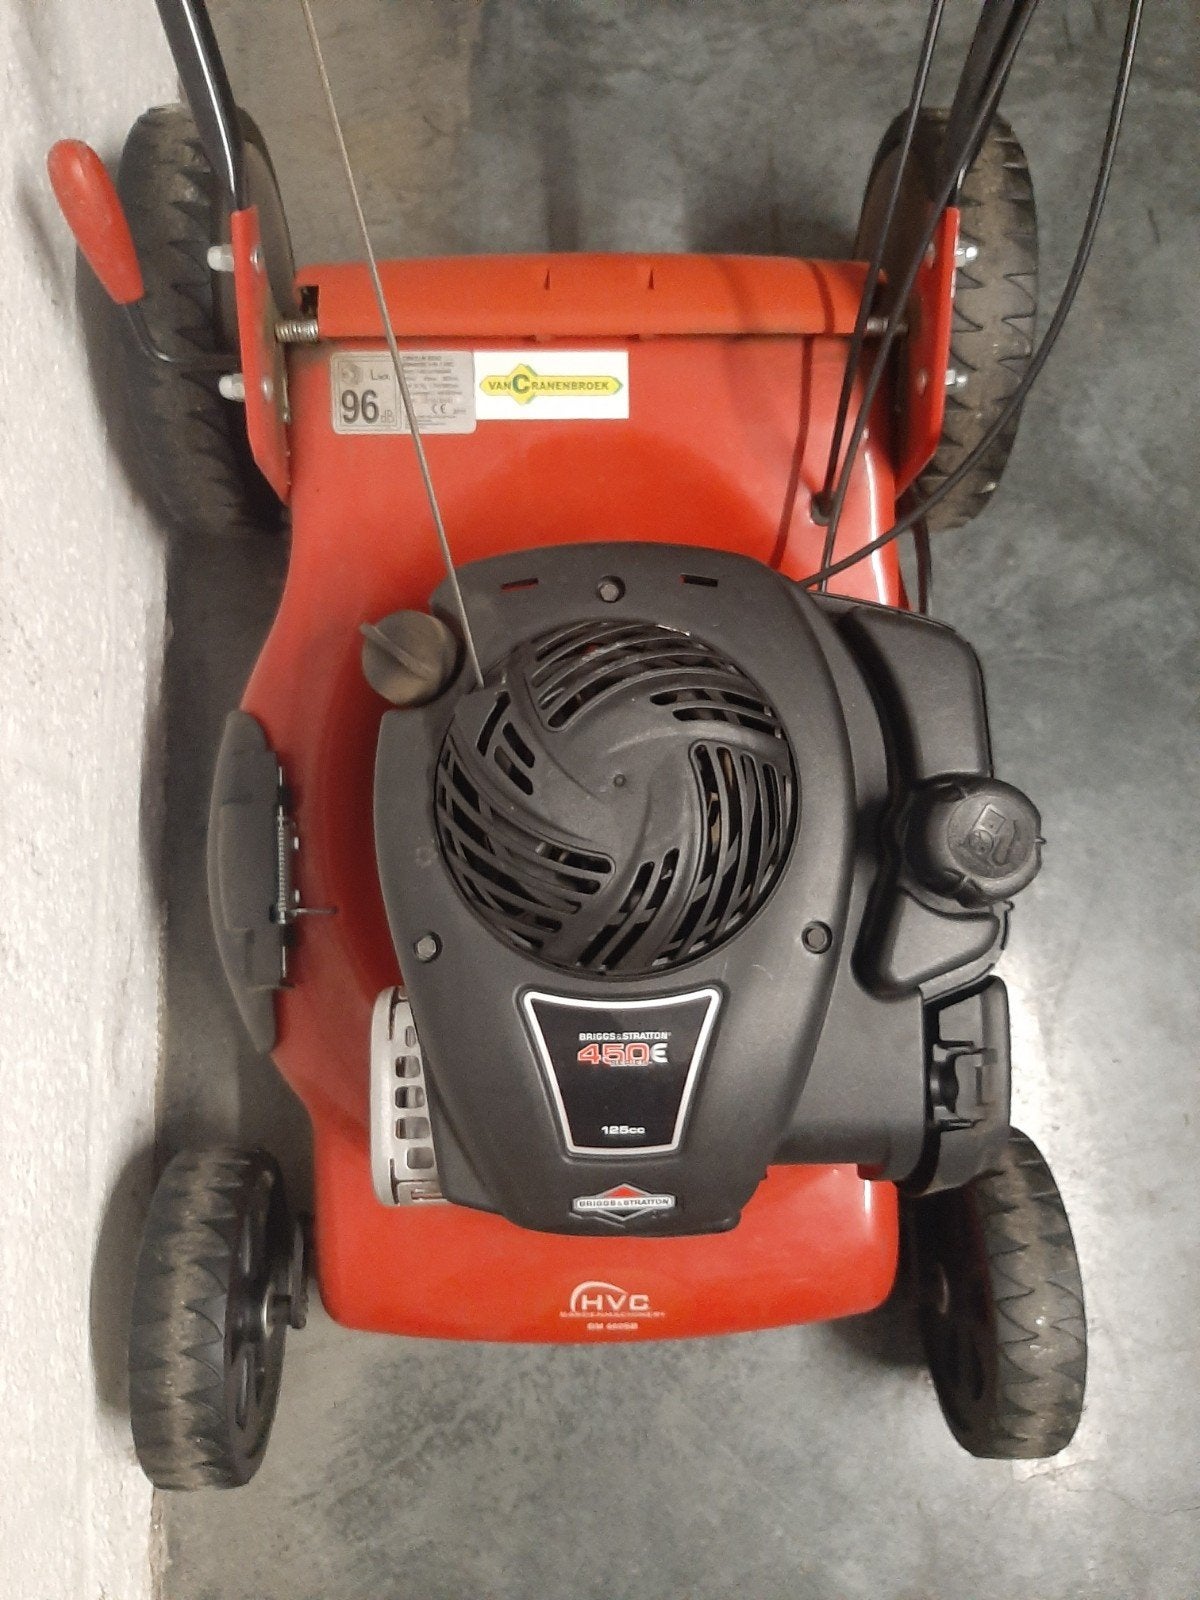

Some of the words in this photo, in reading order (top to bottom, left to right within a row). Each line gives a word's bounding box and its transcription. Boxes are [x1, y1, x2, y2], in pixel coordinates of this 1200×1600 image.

[341, 389, 379, 424] 96
[601, 1125, 646, 1135] 125cc
[581, 1294, 650, 1311] HVC
